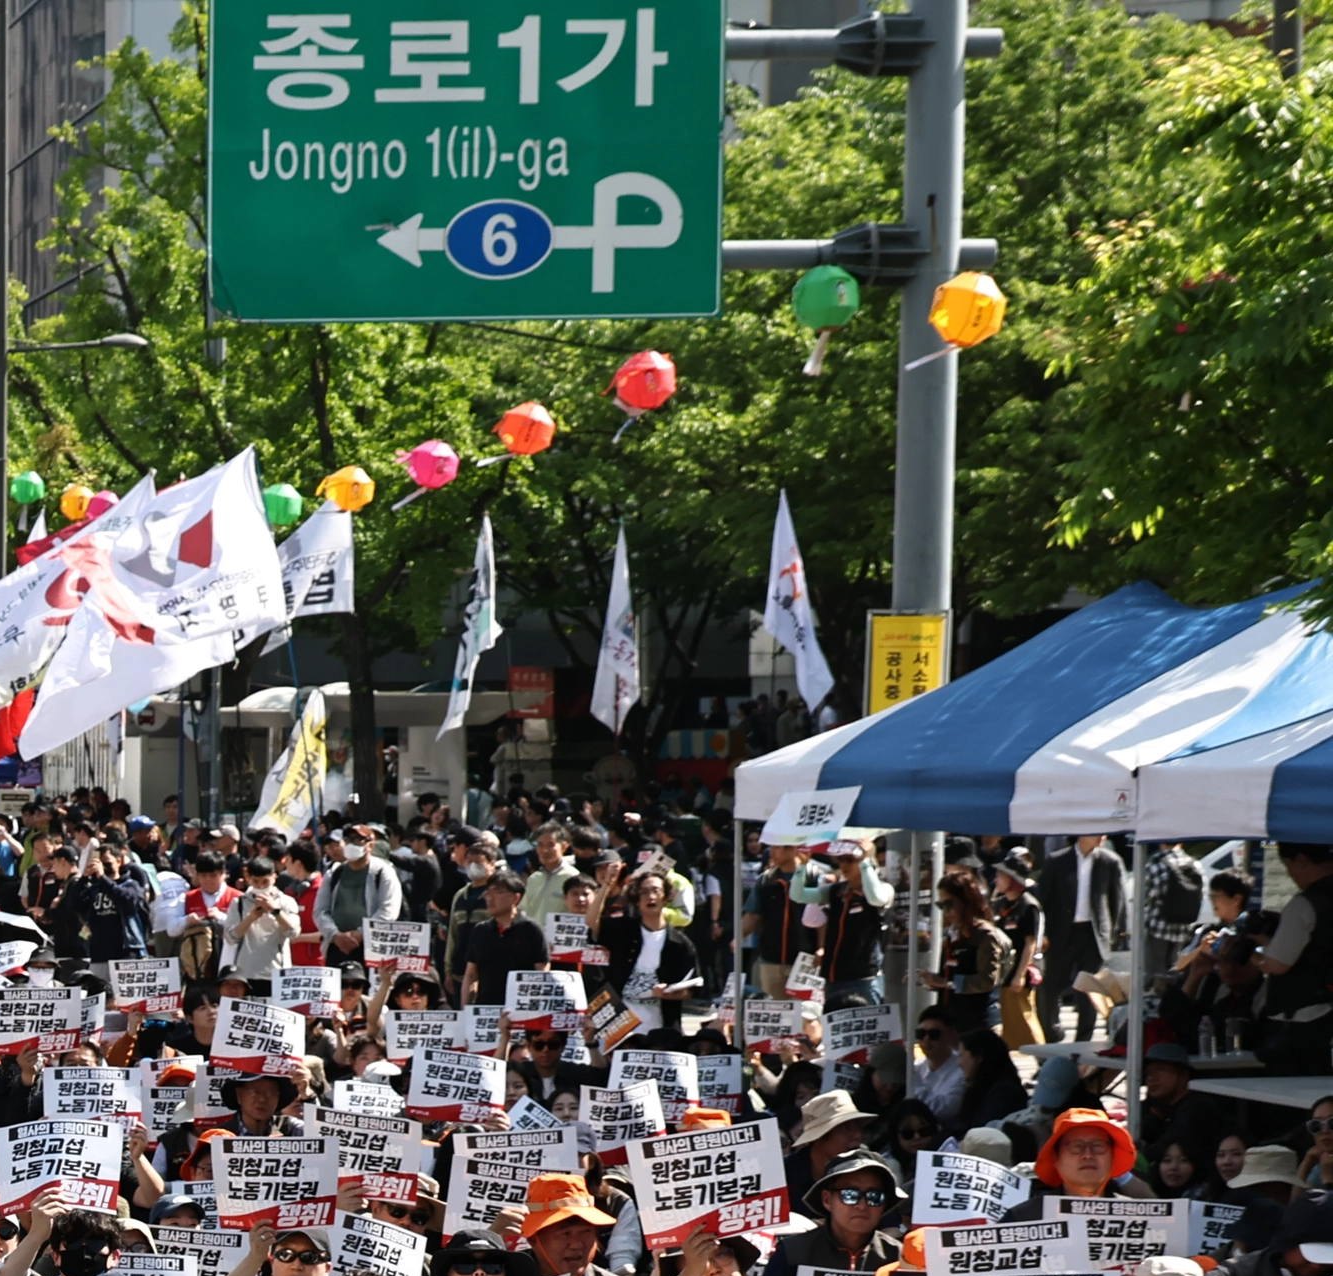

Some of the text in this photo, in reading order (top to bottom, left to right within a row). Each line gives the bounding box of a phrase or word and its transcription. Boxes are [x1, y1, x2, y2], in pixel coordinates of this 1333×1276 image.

[253, 7, 669, 111] 종로1가
[248, 125, 569, 194] Jongno 1(il)-ga
[481, 213, 517, 267] 6
[232, 1141, 266, 1153] 열사의
[221, 1182, 318, 1200] 노동기본권
